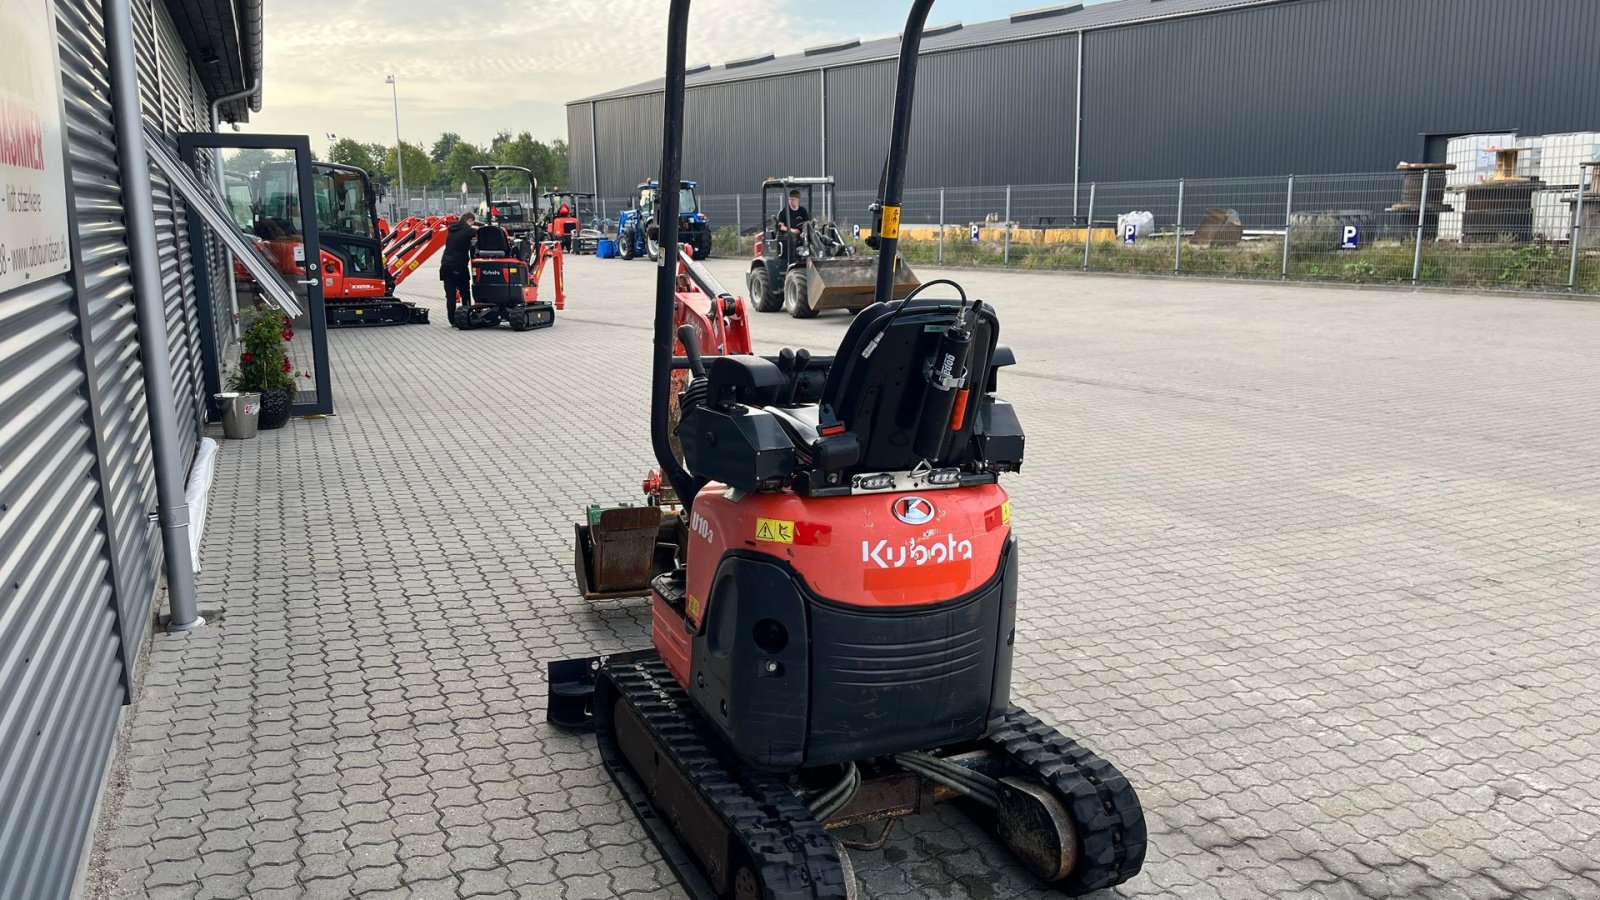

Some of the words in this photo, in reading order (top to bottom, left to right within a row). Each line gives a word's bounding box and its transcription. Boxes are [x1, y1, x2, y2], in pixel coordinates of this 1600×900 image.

[854, 225, 860, 236] P
[971, 225, 978, 238] P
[1125, 225, 1135, 240] P
[1343, 226, 1357, 243] P
[692, 511, 714, 544] U10-3
[861, 533, 973, 569] Kubota
